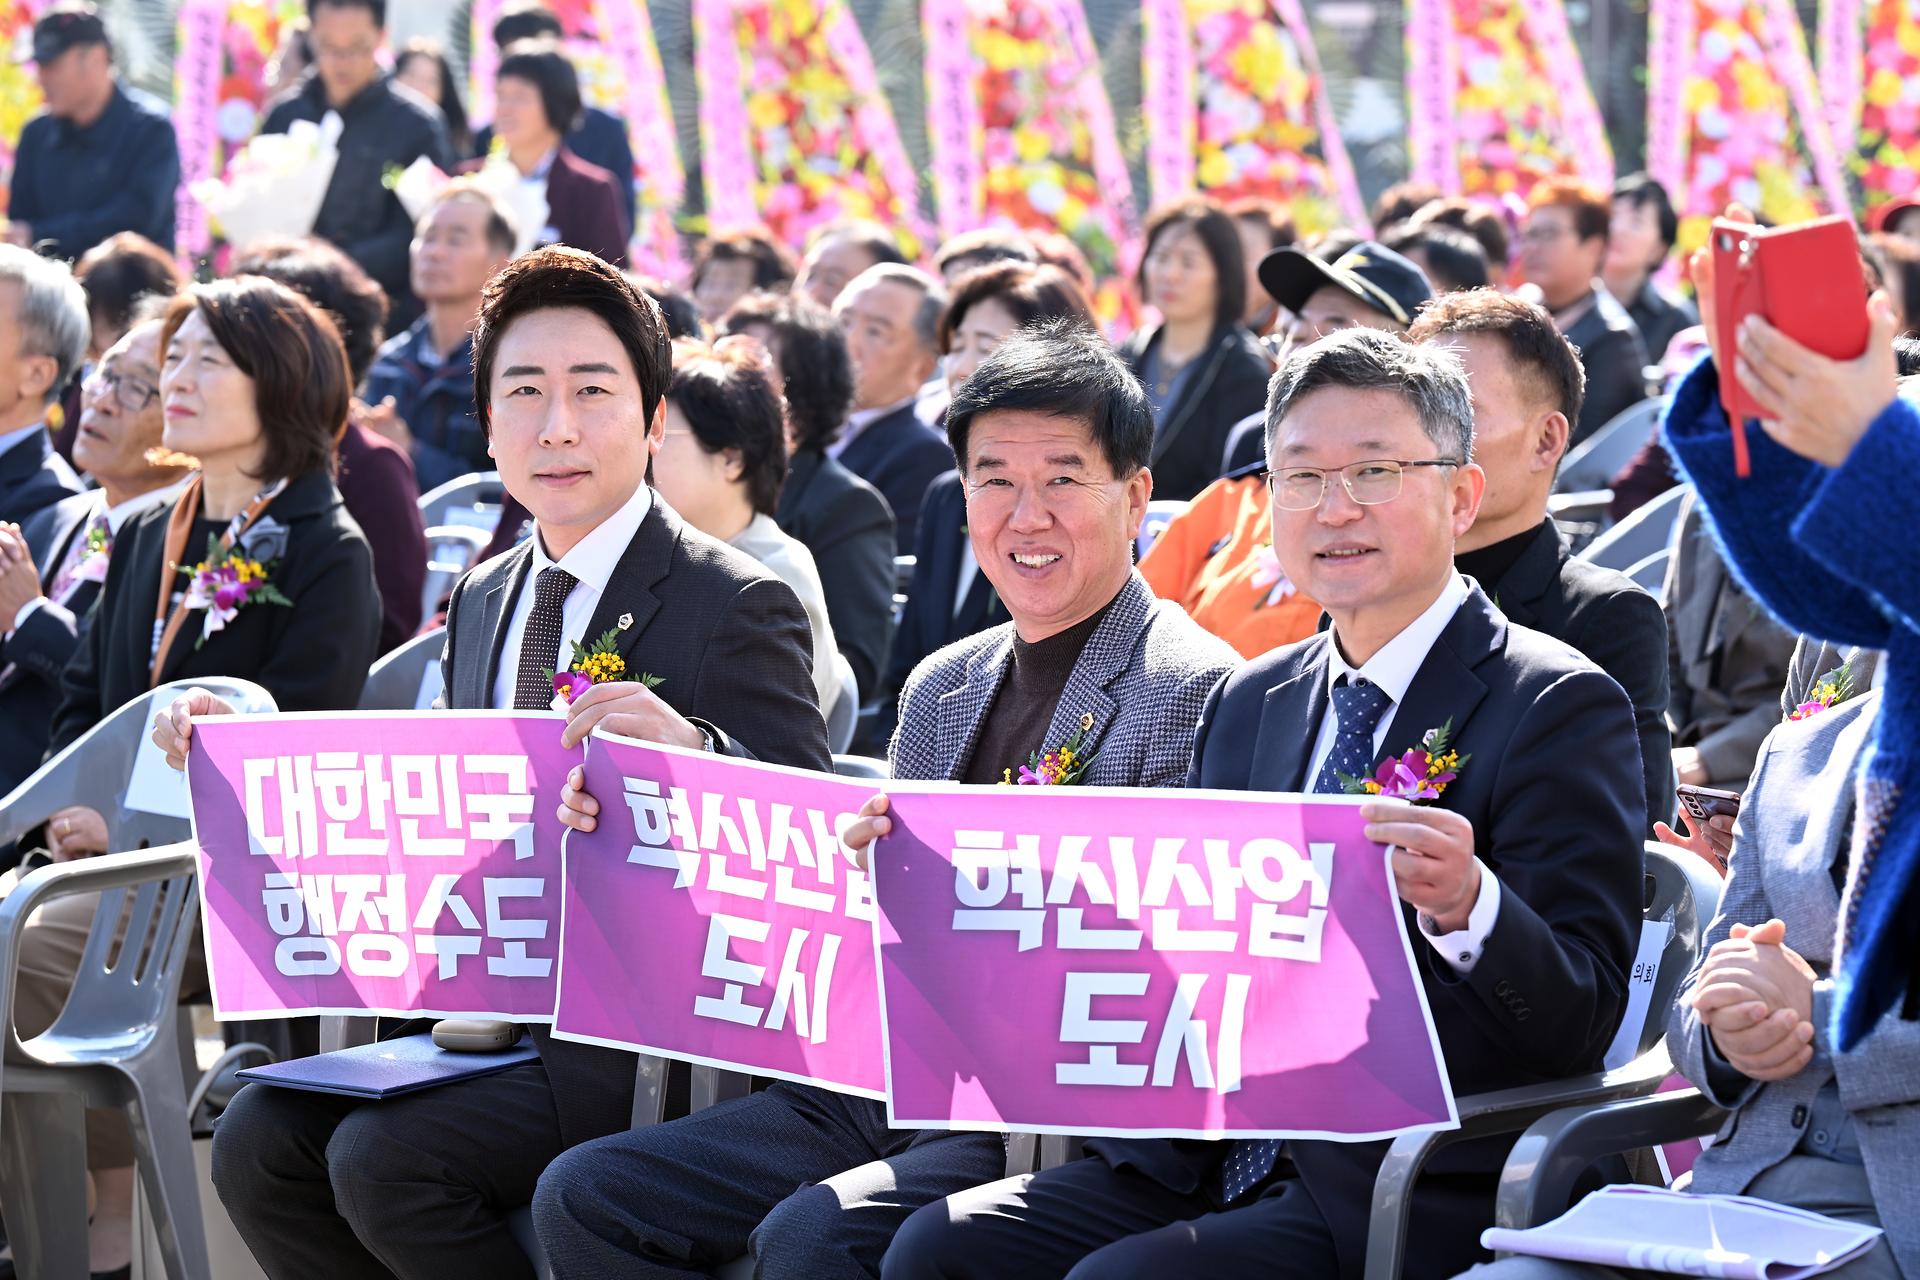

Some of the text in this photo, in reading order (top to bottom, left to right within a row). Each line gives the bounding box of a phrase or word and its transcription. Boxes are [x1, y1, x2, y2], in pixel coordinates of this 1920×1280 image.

[243, 751, 535, 861] 대한민국
[262, 872, 553, 981] 행정수도
[950, 829, 1336, 964] 혁신산업
[693, 912, 843, 1045] 도시
[1055, 972, 1252, 1096] 도시
